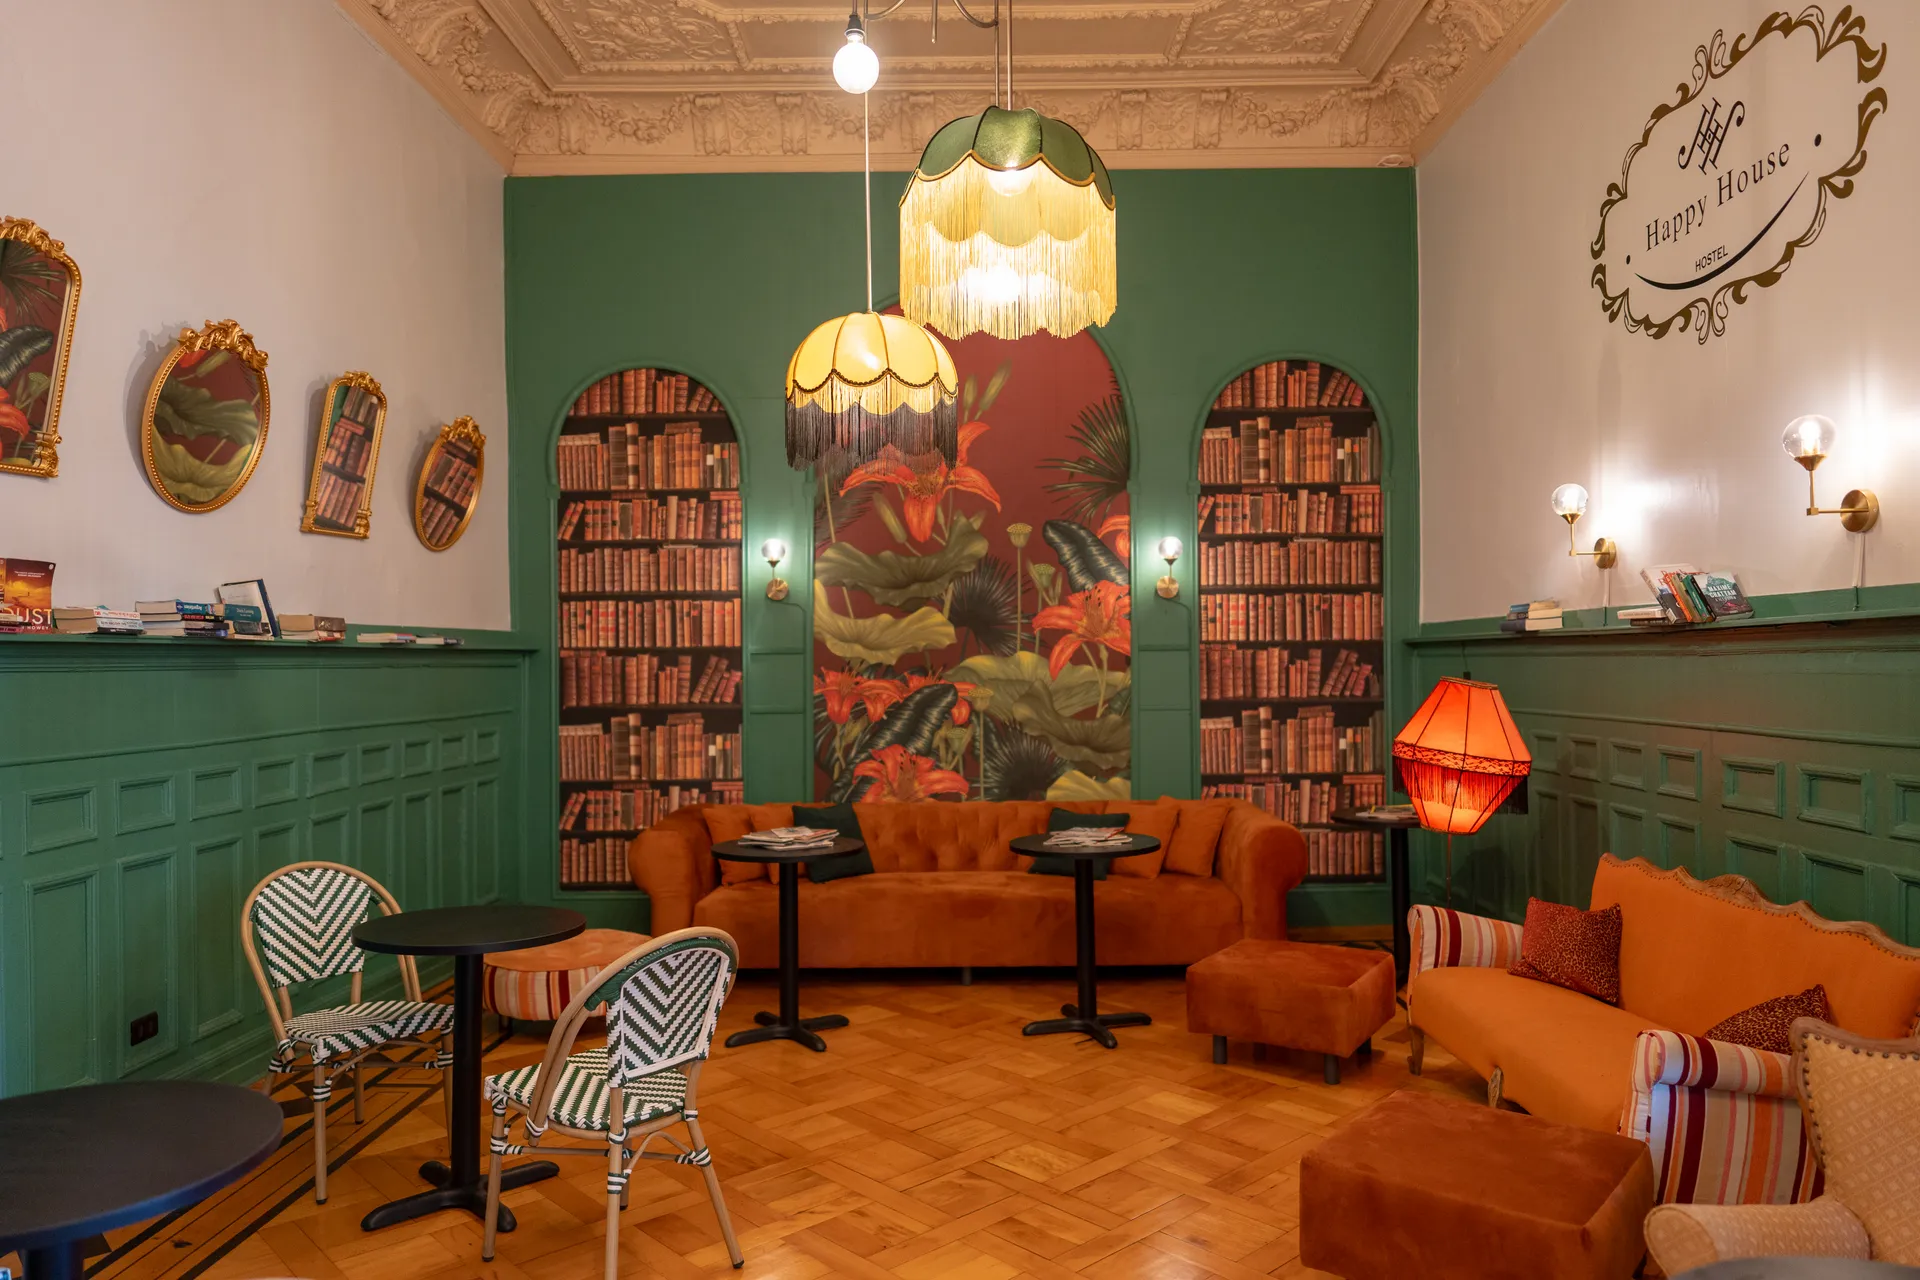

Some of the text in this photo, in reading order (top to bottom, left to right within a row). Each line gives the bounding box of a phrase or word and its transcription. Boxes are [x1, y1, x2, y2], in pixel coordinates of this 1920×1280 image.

[1646, 143, 1789, 251] Happy House
[1695, 245, 1728, 272] HOSTEL
[1707, 584, 1732, 592] MAXIME
